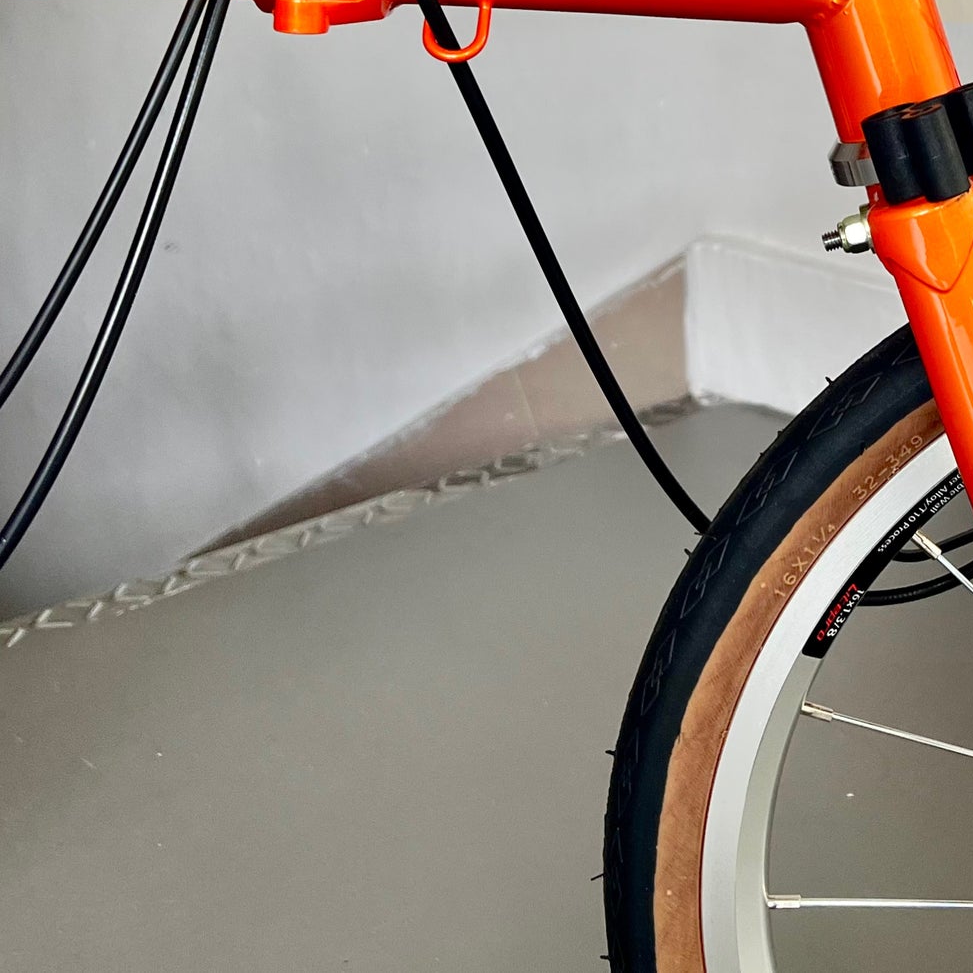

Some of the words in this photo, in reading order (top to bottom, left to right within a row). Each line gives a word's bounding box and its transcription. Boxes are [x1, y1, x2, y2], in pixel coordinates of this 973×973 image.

[852, 435, 924, 500] 32-349
[930, 496, 951, 514] Wall
[877, 522, 910, 553] Process
